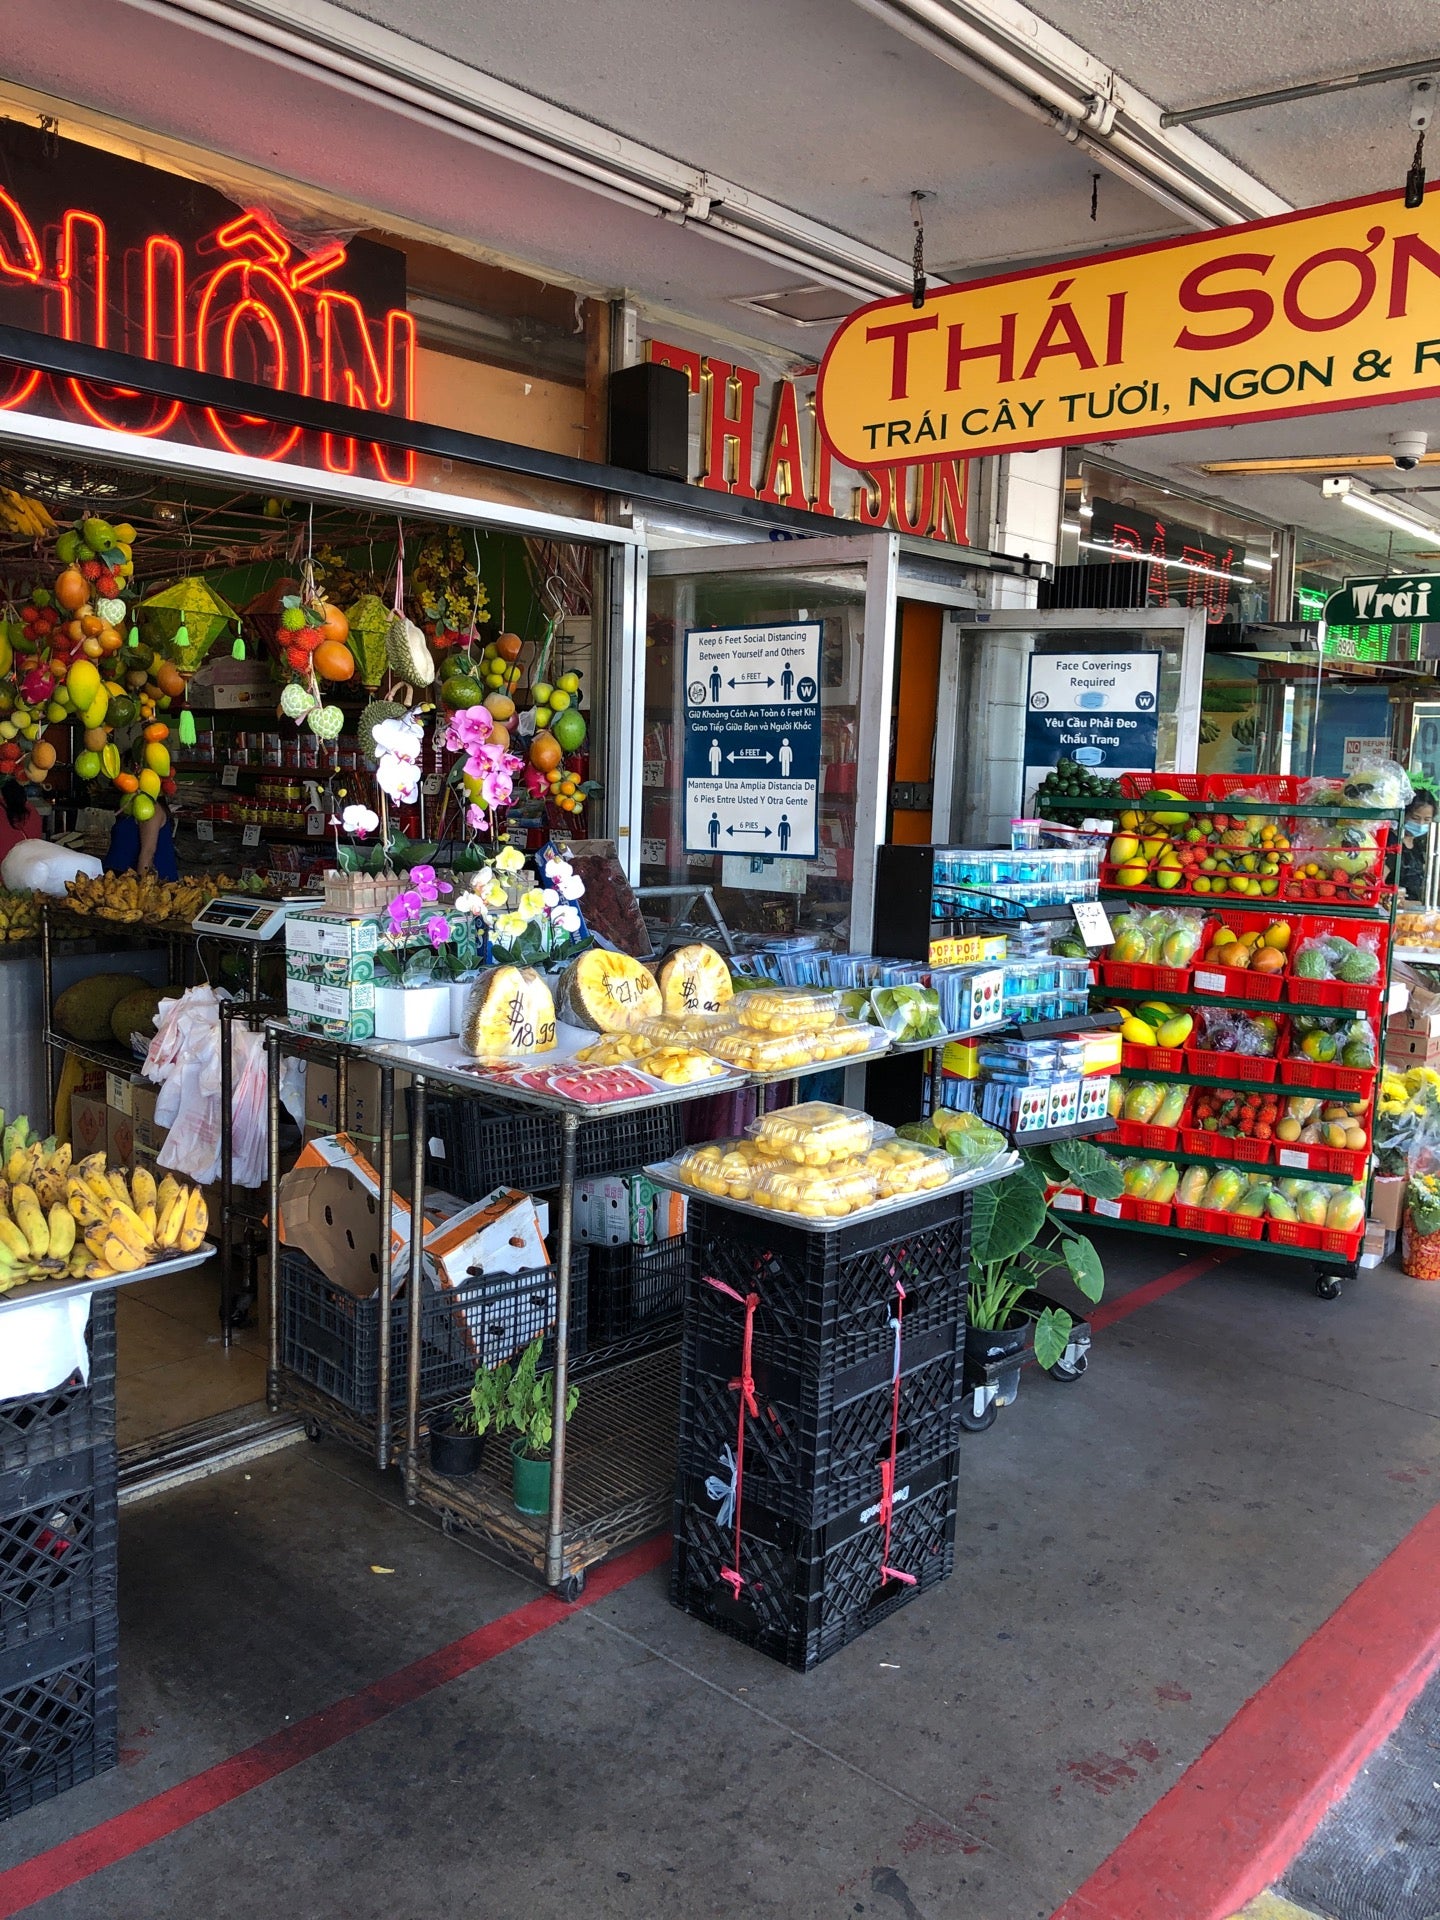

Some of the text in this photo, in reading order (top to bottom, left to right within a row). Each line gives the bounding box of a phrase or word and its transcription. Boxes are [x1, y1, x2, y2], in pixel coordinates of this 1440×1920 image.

[866, 278, 1128, 400] THÁI
[862, 409, 948, 450] TRÁI
[961, 397, 1047, 434] CÂY
[1059, 379, 1170, 423] TƯƠI,
[1188, 356, 1334, 407] NGON
[1353, 348, 1392, 382] &
[1352, 581, 1432, 619] Trái
[699, 631, 807, 648] Keep 6 Feet Social Distancing
[700, 647, 805, 660] Between Yourself and Others
[1056, 661, 1132, 672] Face Coverings
[747, 672, 761, 680] FEET
[1070, 677, 1116, 688] Required
[689, 710, 701, 718] Giữ
[702, 709, 728, 720] Khoảng
[730, 708, 747, 718] Cách
[760, 708, 778, 717] Toàn
[787, 708, 803, 716] Feet
[804, 708, 816, 716] Khi
[692, 720, 812, 733] Giao Tiếp Giữa Bạn và Người Khác
[1044, 716, 1137, 728] Yêu Cầu Phải Đeo
[1089, 734, 1120, 746] Trang
[745, 748, 760, 756] FEET
[1347, 742, 1360, 753] NO
[688, 781, 815, 791] Mantenga Una Amplia Distancia De
[693, 795, 808, 805] 6 Pies Entre Usted Y Otra Gente
[508, 991, 523, 1027] $
[512, 1021, 556, 1047] 18.99
